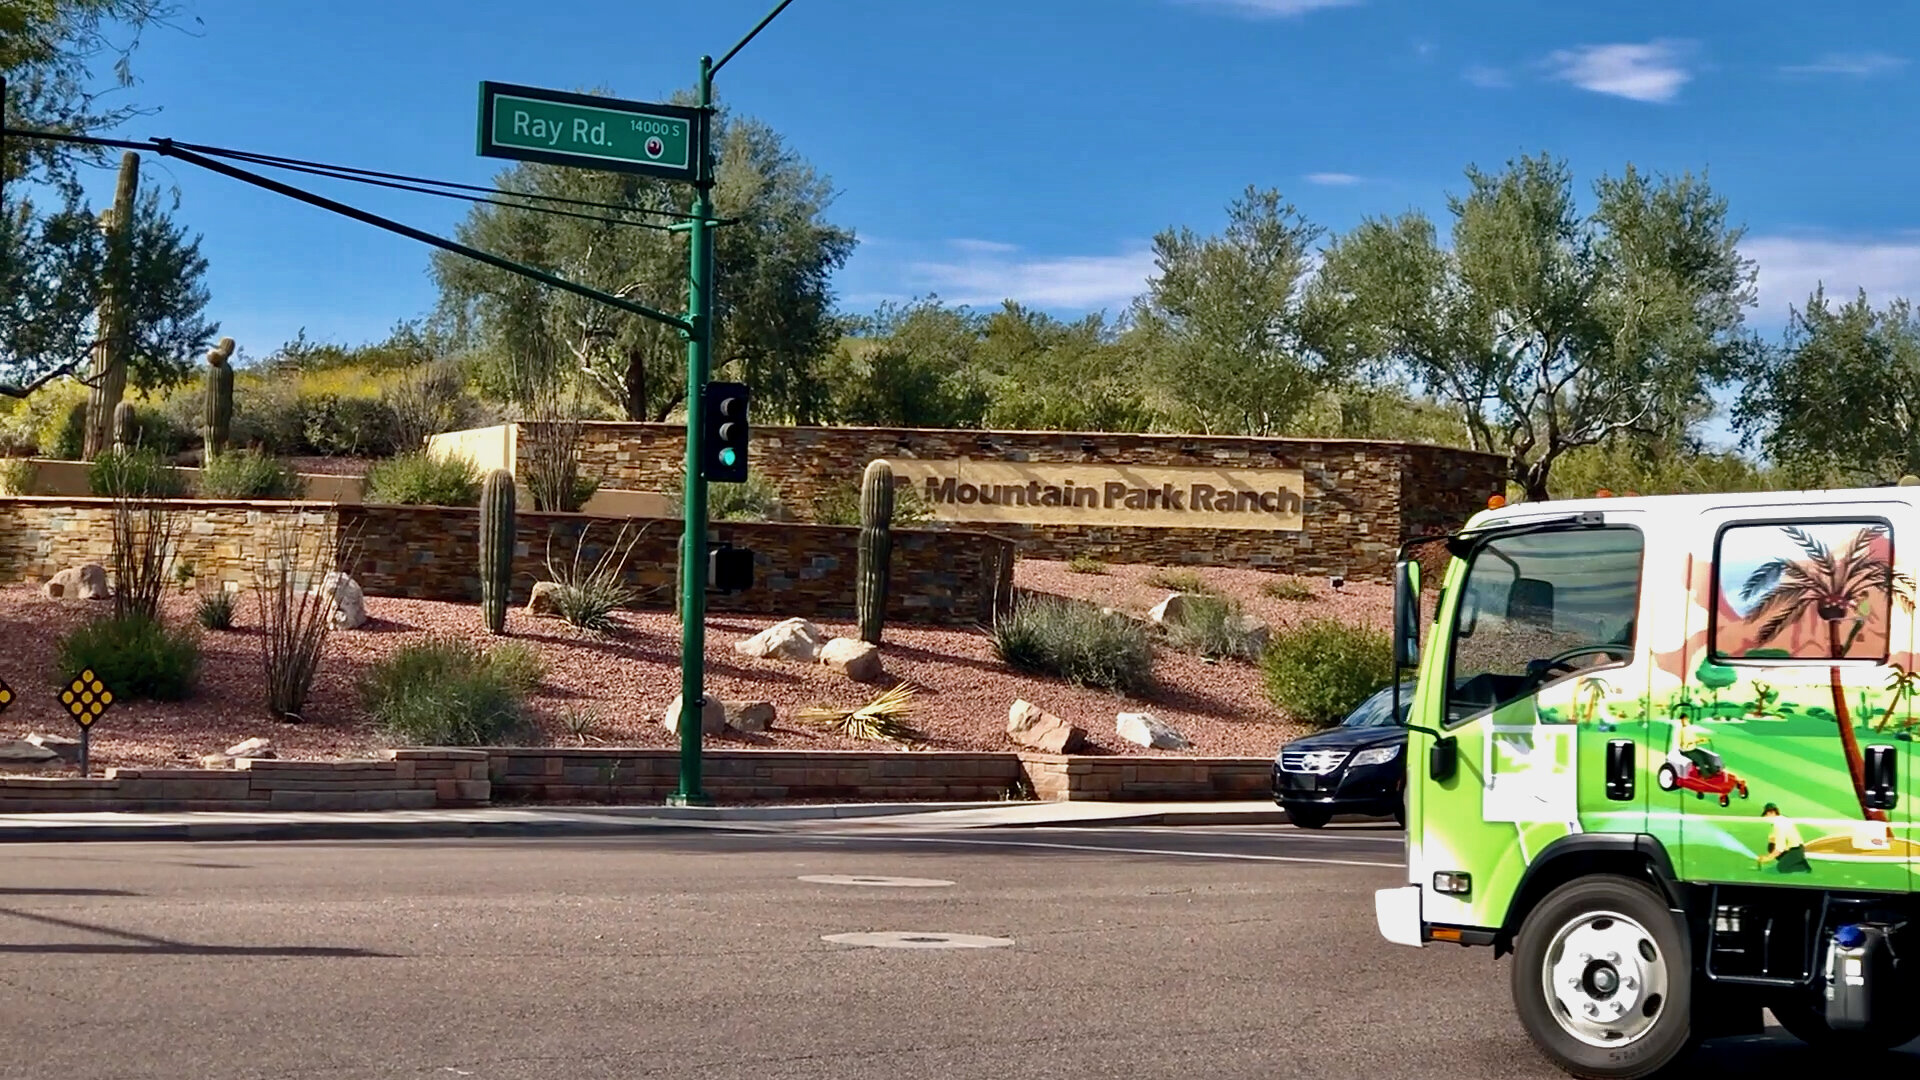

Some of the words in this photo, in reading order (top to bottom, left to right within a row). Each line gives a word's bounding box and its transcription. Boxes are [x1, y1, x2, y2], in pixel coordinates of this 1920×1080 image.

[514, 110, 563, 146] Ray
[572, 117, 613, 147] Rd.
[630, 119, 669, 135] 14000
[672, 124, 680, 137] S
[925, 476, 1099, 509] Mountain
[1103, 481, 1185, 511] Park
[1189, 483, 1301, 513] Ranch
